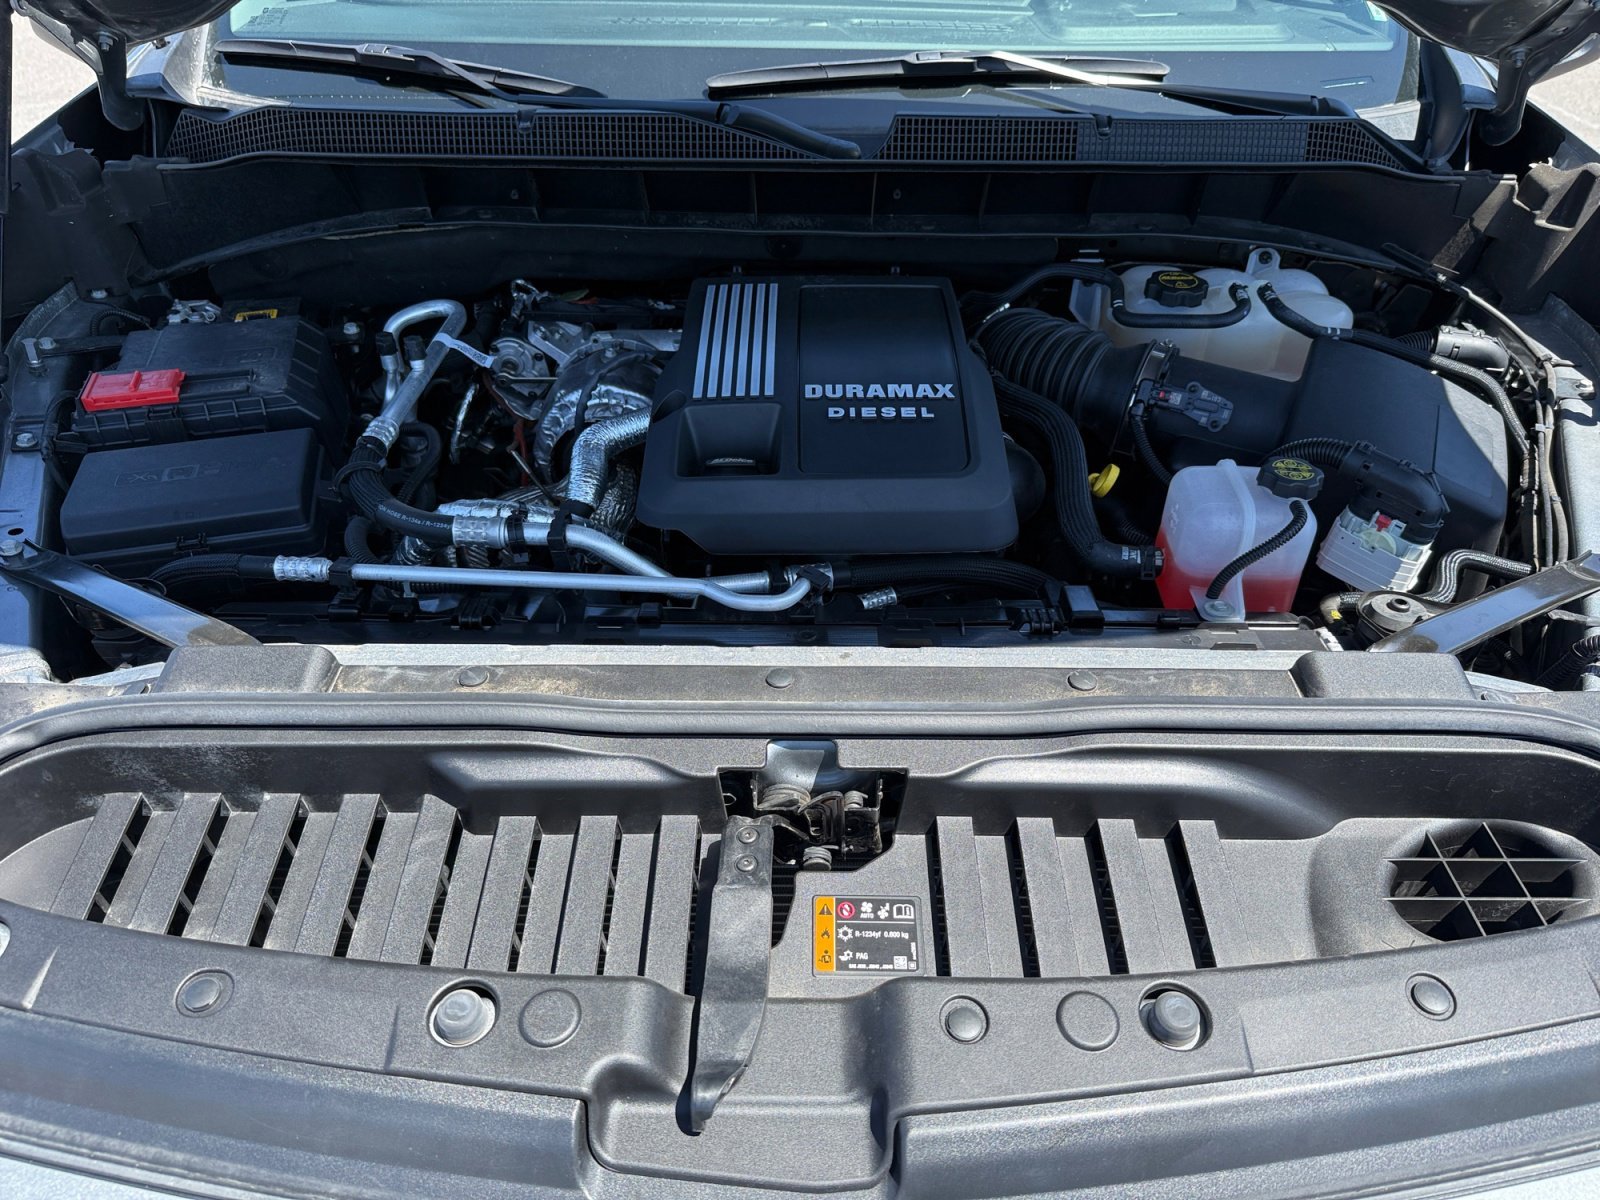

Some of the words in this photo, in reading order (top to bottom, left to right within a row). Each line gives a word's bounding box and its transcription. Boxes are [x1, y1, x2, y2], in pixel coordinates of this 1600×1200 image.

[804, 383, 955, 398] DURAMAX
[828, 407, 935, 418] DIESEL
[855, 930, 881, 939] R-1234yf
[901, 931, 909, 940] kg
[855, 952, 869, 960] PAG
